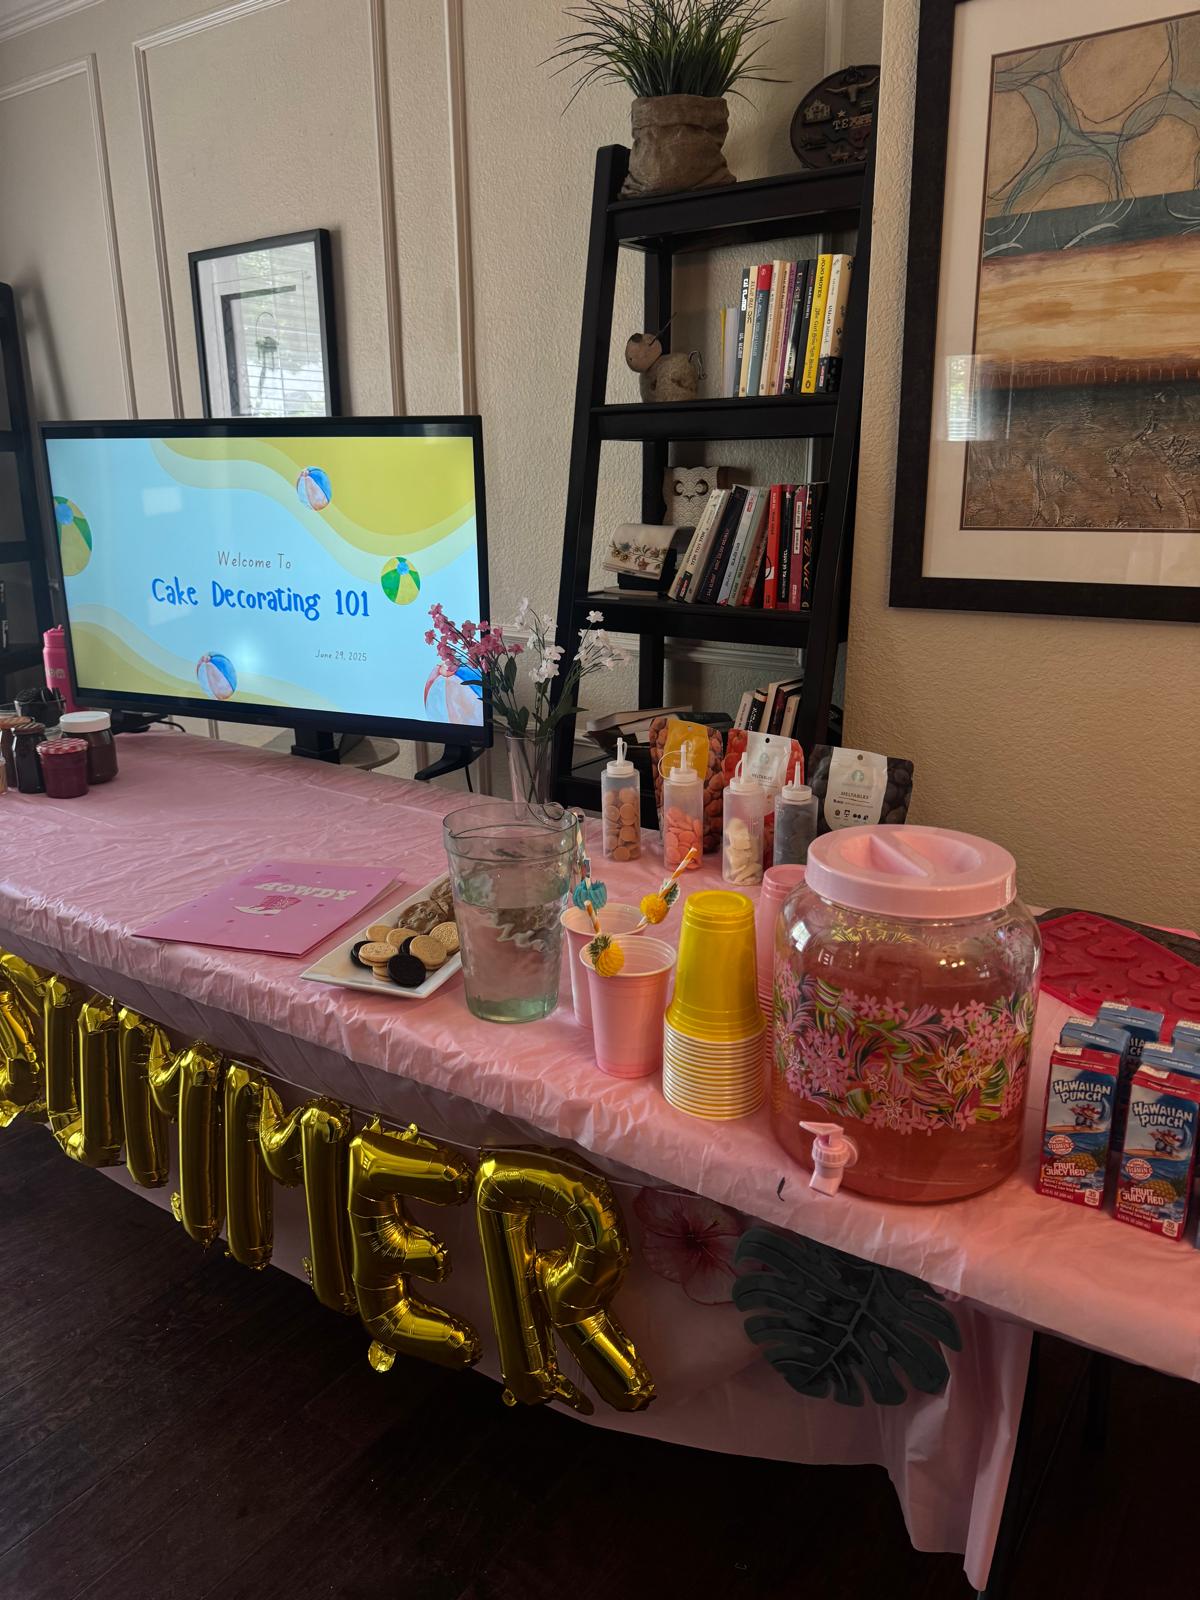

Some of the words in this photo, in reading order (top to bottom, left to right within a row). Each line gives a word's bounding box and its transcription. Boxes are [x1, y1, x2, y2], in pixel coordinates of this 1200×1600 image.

[217, 550, 272, 569] Welcome
[277, 553, 292, 570] To
[151, 576, 199, 606] Cake
[211, 580, 321, 621] Decorating
[335, 588, 370, 617] 101
[315, 649, 332, 659] June
[335, 651, 346, 661] 29,
[349, 651, 368, 661] 2025
[840, 791, 869, 800] MELTABLES
[253, 882, 358, 901] HOWDY
[1053, 1080, 1111, 1095] HAWAIIAN
[1060, 1091, 1102, 1104] PUNCH
[1132, 1102, 1193, 1122] HAWAIIAN
[1138, 1114, 1184, 1128] PUNCH
[1046, 1168, 1068, 1176] JUICY
[1053, 1162, 1076, 1170] FRUIT
[1130, 1187, 1155, 1196] FRUIT
[1122, 1192, 1146, 1203] JUICY
[1147, 1196, 1164, 1205] RED
